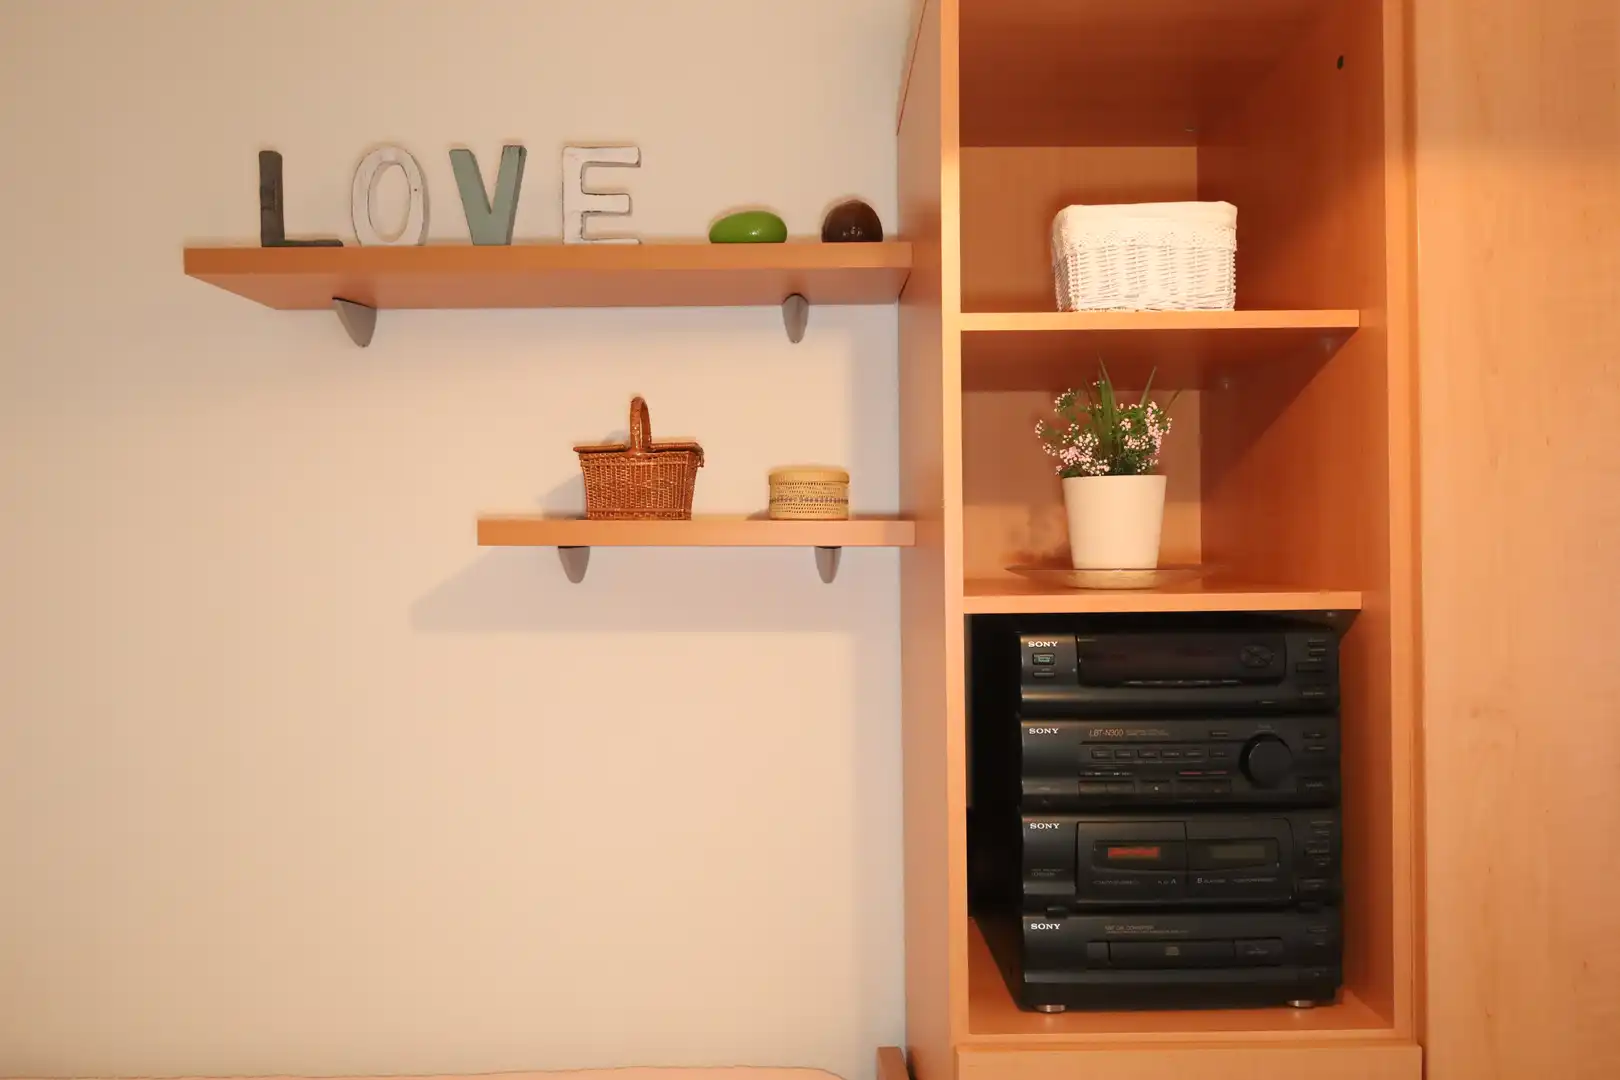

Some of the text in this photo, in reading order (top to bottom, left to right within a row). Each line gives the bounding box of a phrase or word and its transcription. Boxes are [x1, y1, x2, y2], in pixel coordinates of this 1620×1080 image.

[259, 145, 641, 247] LOVE
[1028, 640, 1058, 648] SONY
[1028, 727, 1059, 735] SONY
[1088, 728, 1124, 738] LBT-N300
[1029, 822, 1060, 830] SONY
